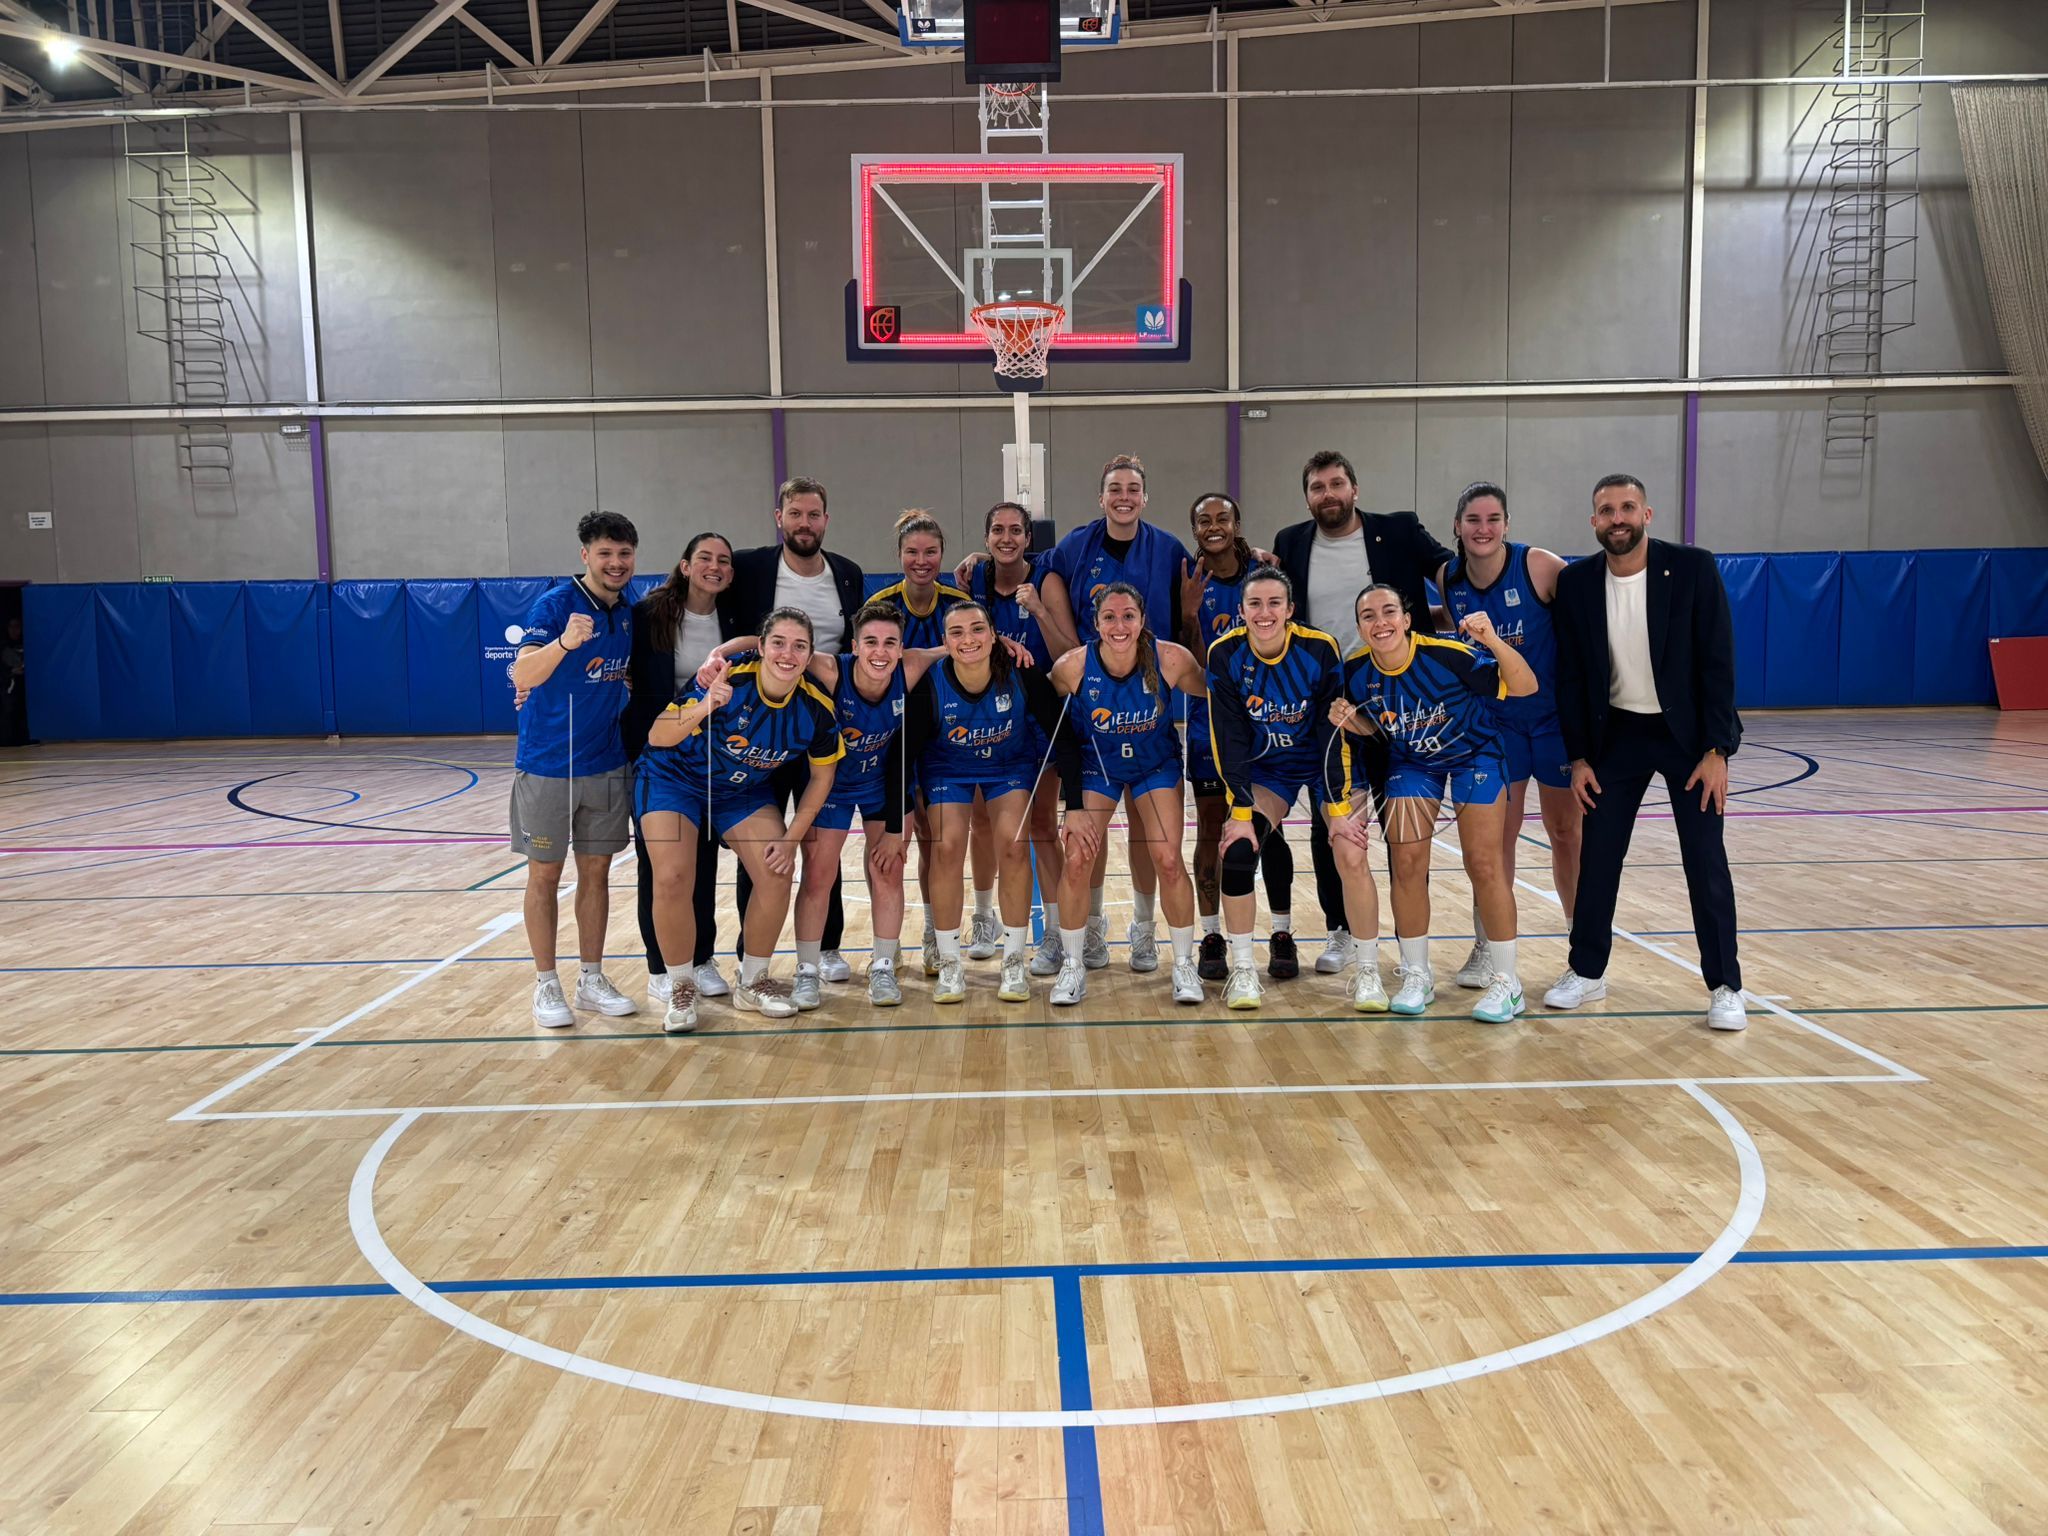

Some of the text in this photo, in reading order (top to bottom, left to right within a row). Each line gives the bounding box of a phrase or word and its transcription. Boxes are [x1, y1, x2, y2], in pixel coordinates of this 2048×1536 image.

[485, 650, 513, 660] deporte
[1116, 719, 1157, 735] DEPORTE
[1268, 733, 1294, 748] 18
[1408, 736, 1443, 753] 20
[1121, 743, 1134, 758] 6
[728, 770, 749, 783] 8
